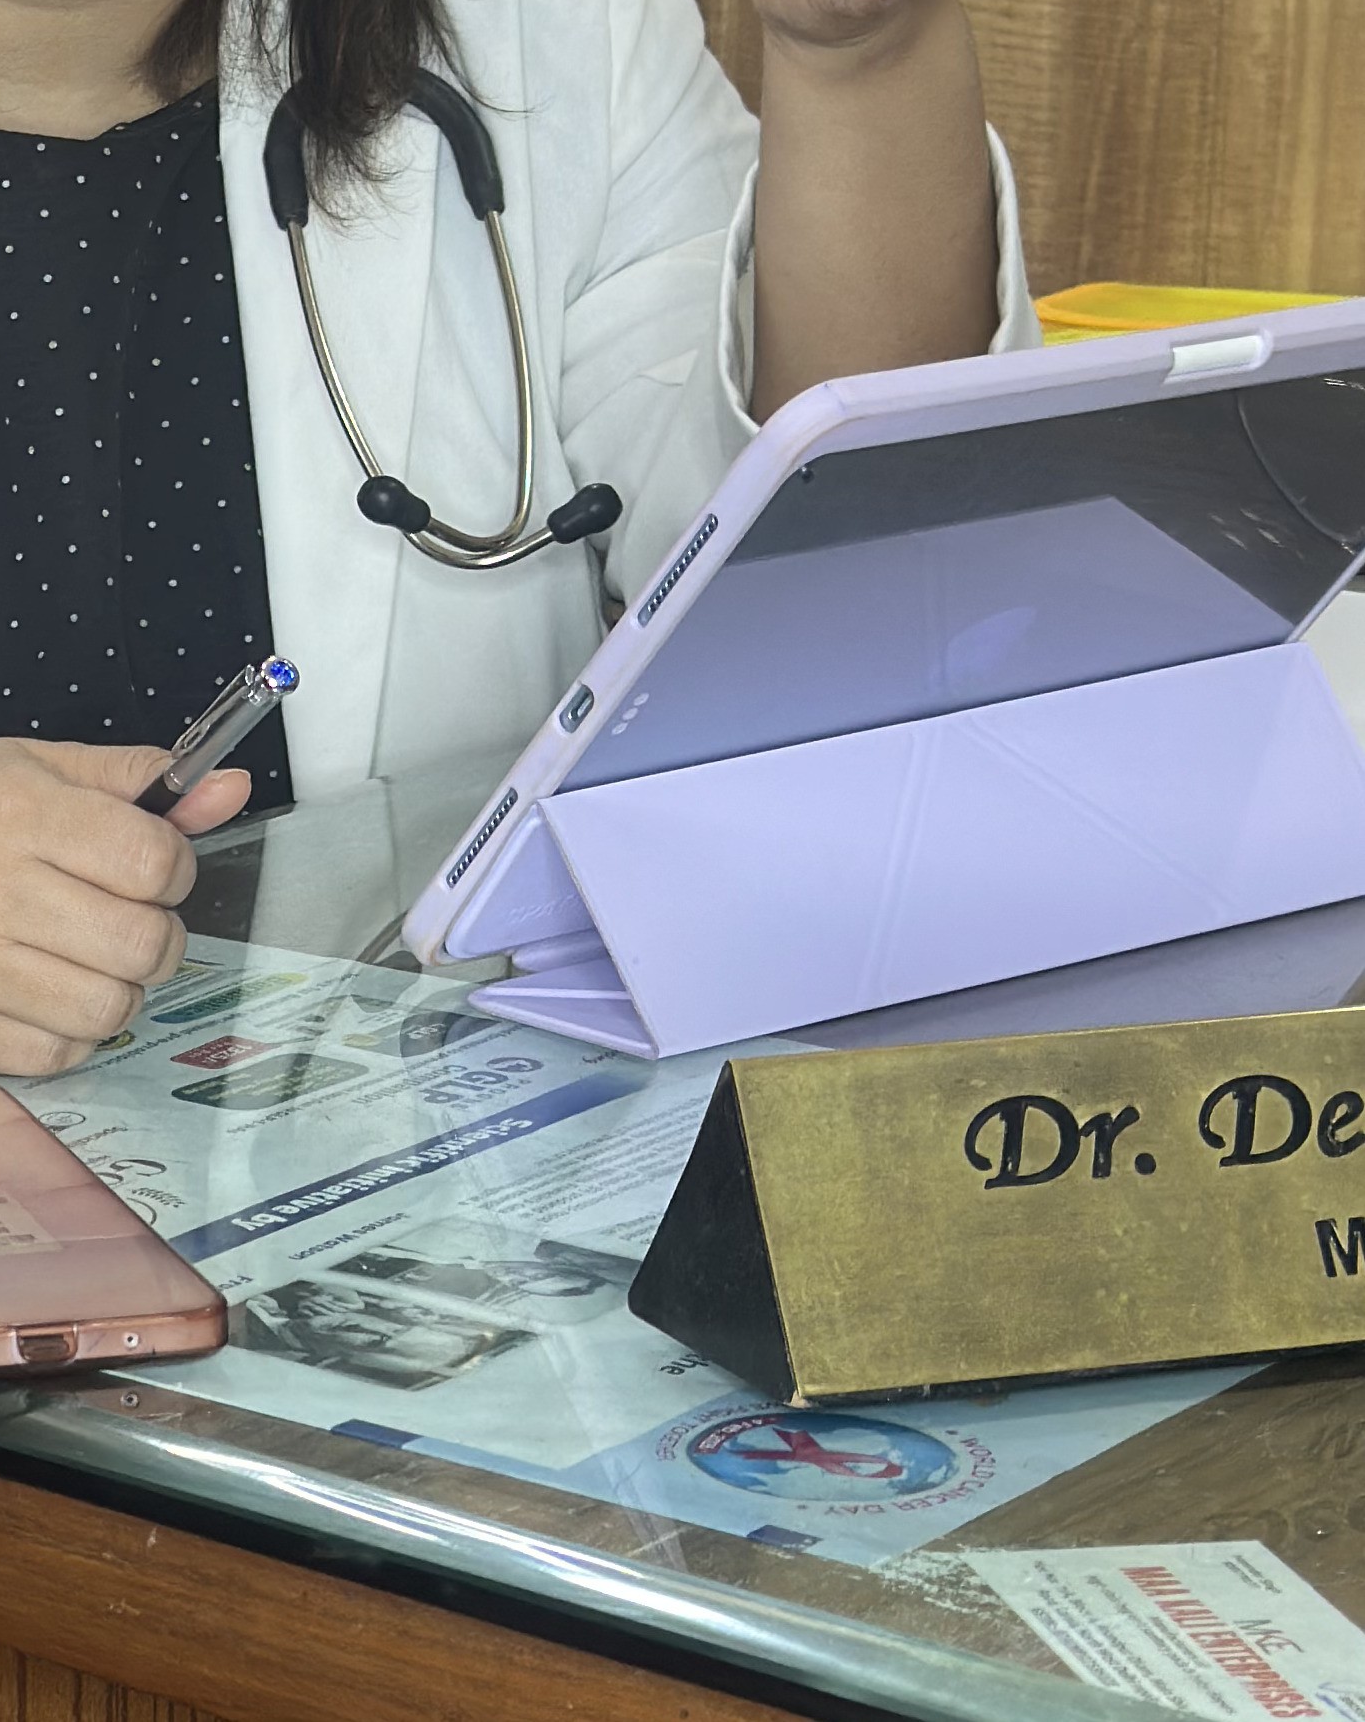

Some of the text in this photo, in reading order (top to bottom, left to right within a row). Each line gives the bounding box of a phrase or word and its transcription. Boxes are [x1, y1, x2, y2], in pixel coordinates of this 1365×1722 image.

[394, 1116, 534, 1175] Scientific
[963, 1093, 1158, 1190] Dr.
[230, 1206, 290, 1232] by
[823, 1503, 886, 1517] DAY
[895, 1477, 981, 1513] CANCER
